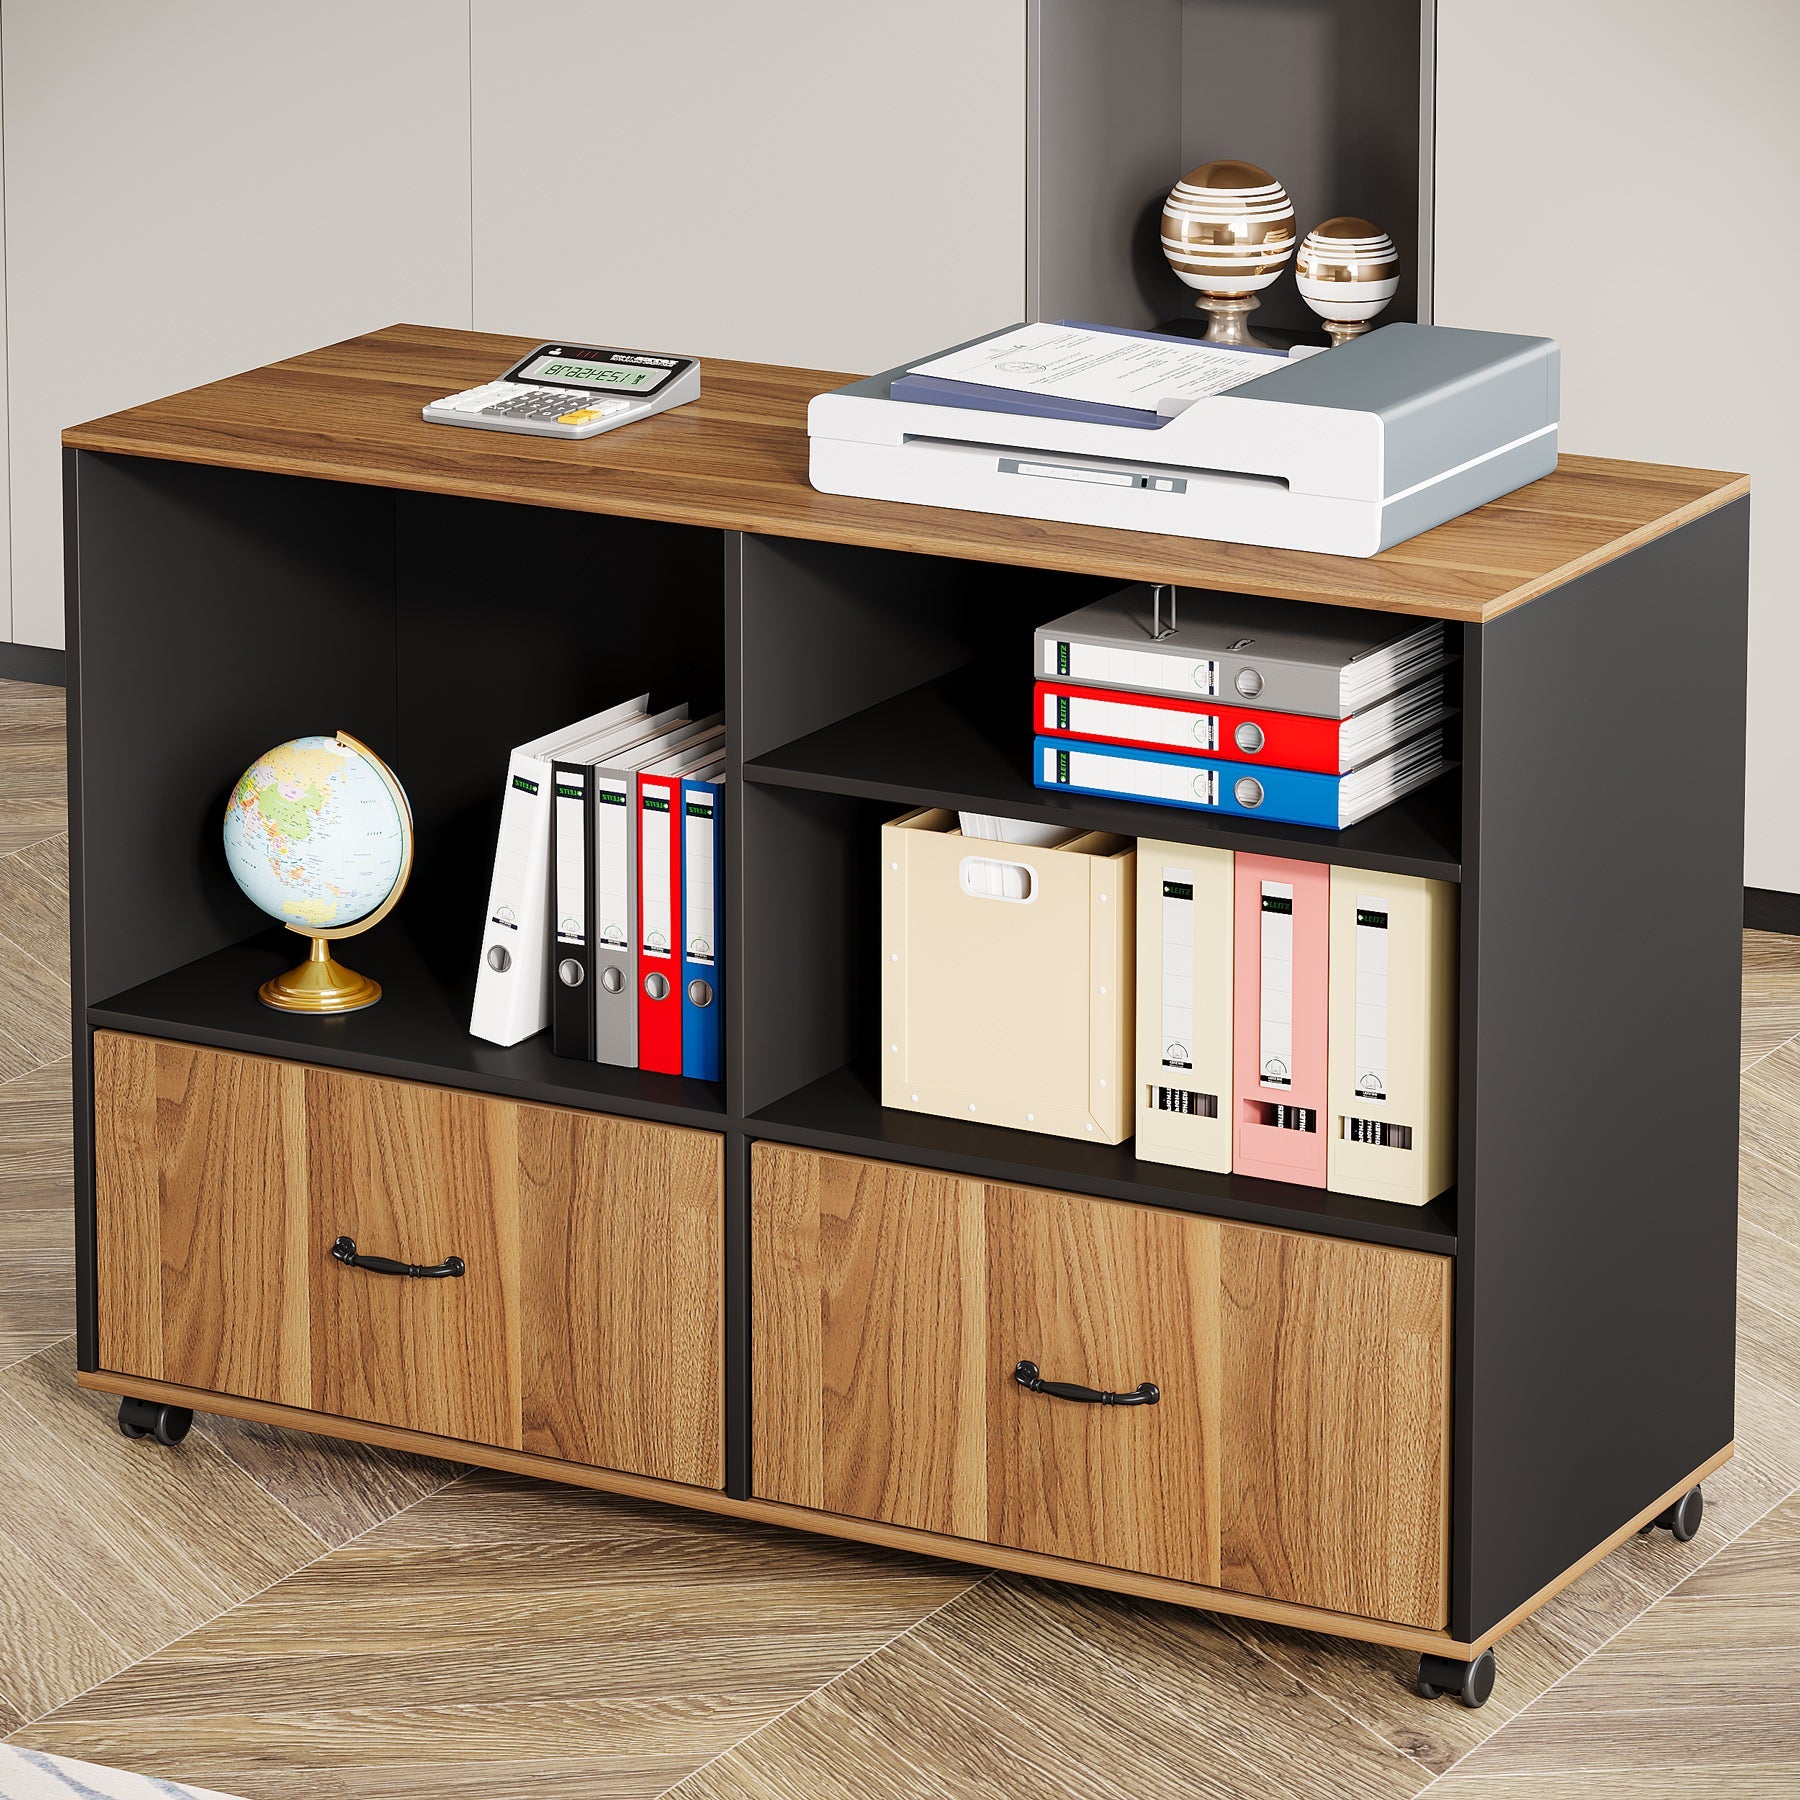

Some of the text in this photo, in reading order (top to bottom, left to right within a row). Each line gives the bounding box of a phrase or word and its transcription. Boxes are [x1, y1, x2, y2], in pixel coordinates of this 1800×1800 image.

[1170, 887, 1191, 896] LEITZ
[1269, 900, 1290, 910] LEITZ
[1364, 914, 1385, 924] LEITZ
